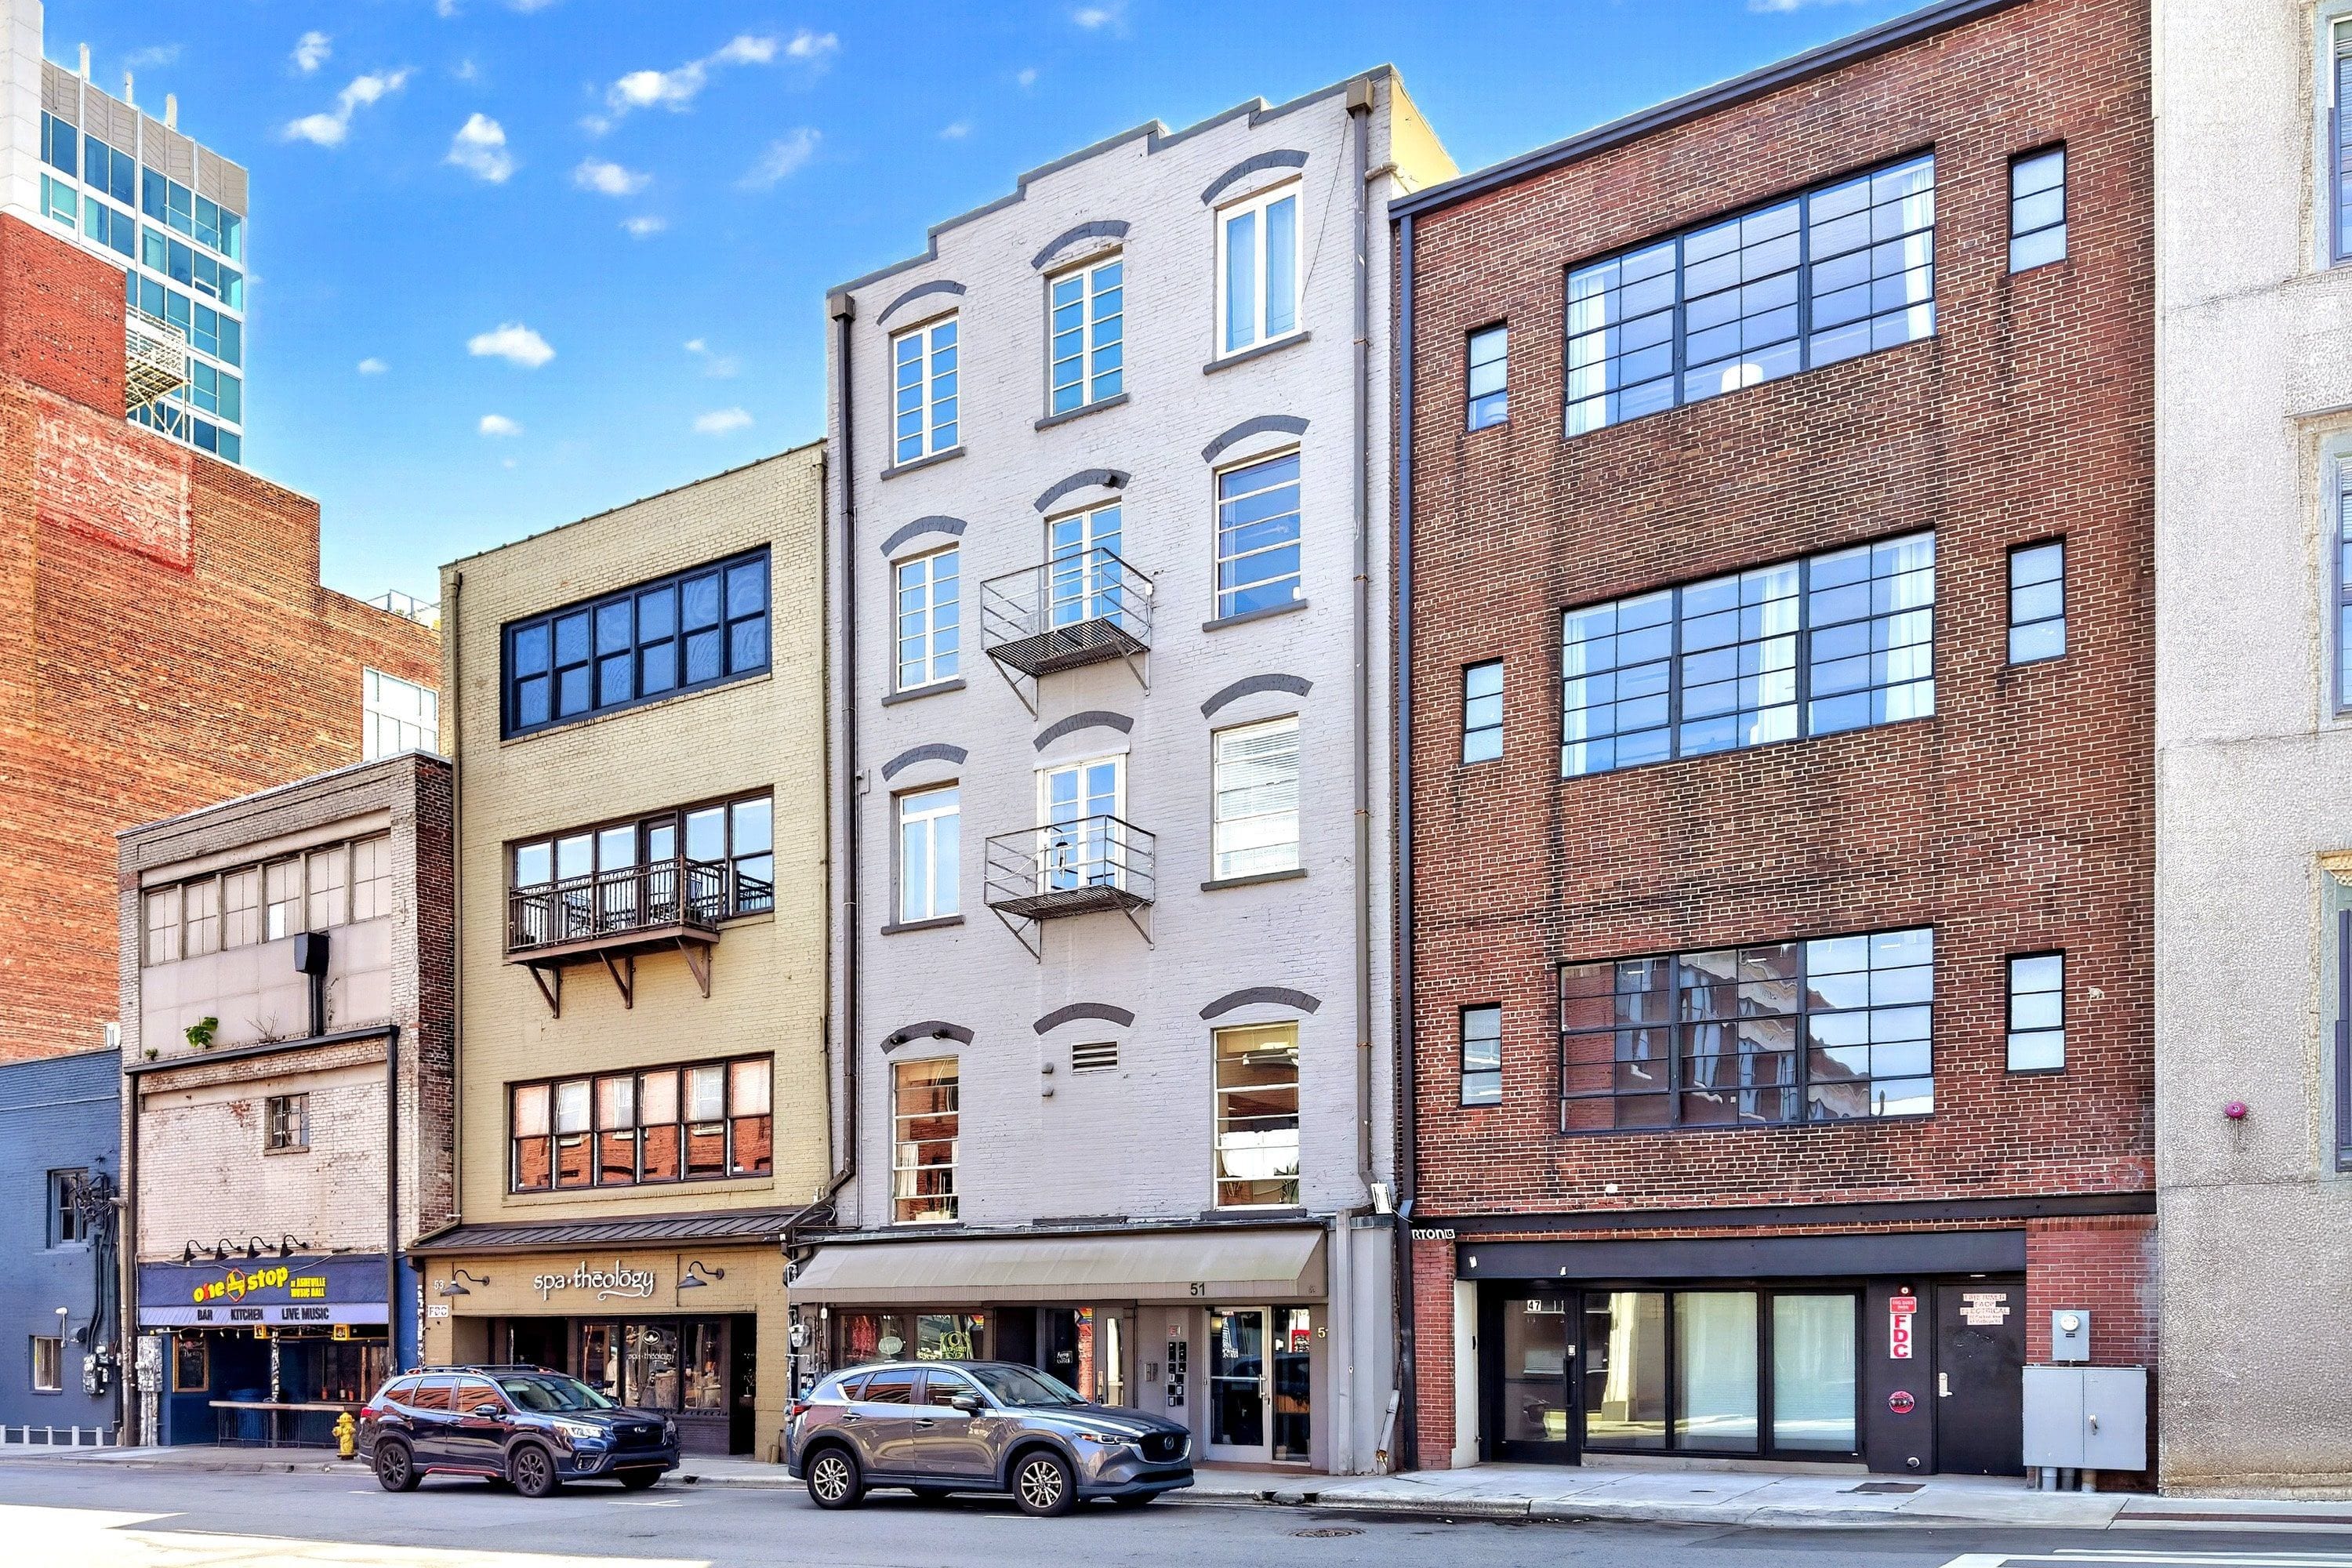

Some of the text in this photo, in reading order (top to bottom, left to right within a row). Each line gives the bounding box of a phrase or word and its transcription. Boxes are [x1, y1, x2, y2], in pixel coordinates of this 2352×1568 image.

[247, 1266, 289, 1292] stop
[291, 1287, 325, 1298] MUSIC HALL
[1190, 1283, 1206, 1296] 51
[1528, 1301, 1541, 1310] 47
[198, 1307, 329, 1320] BAR KITCHEN LIVE MUSIC
[1318, 1327, 1329, 1338] 5
